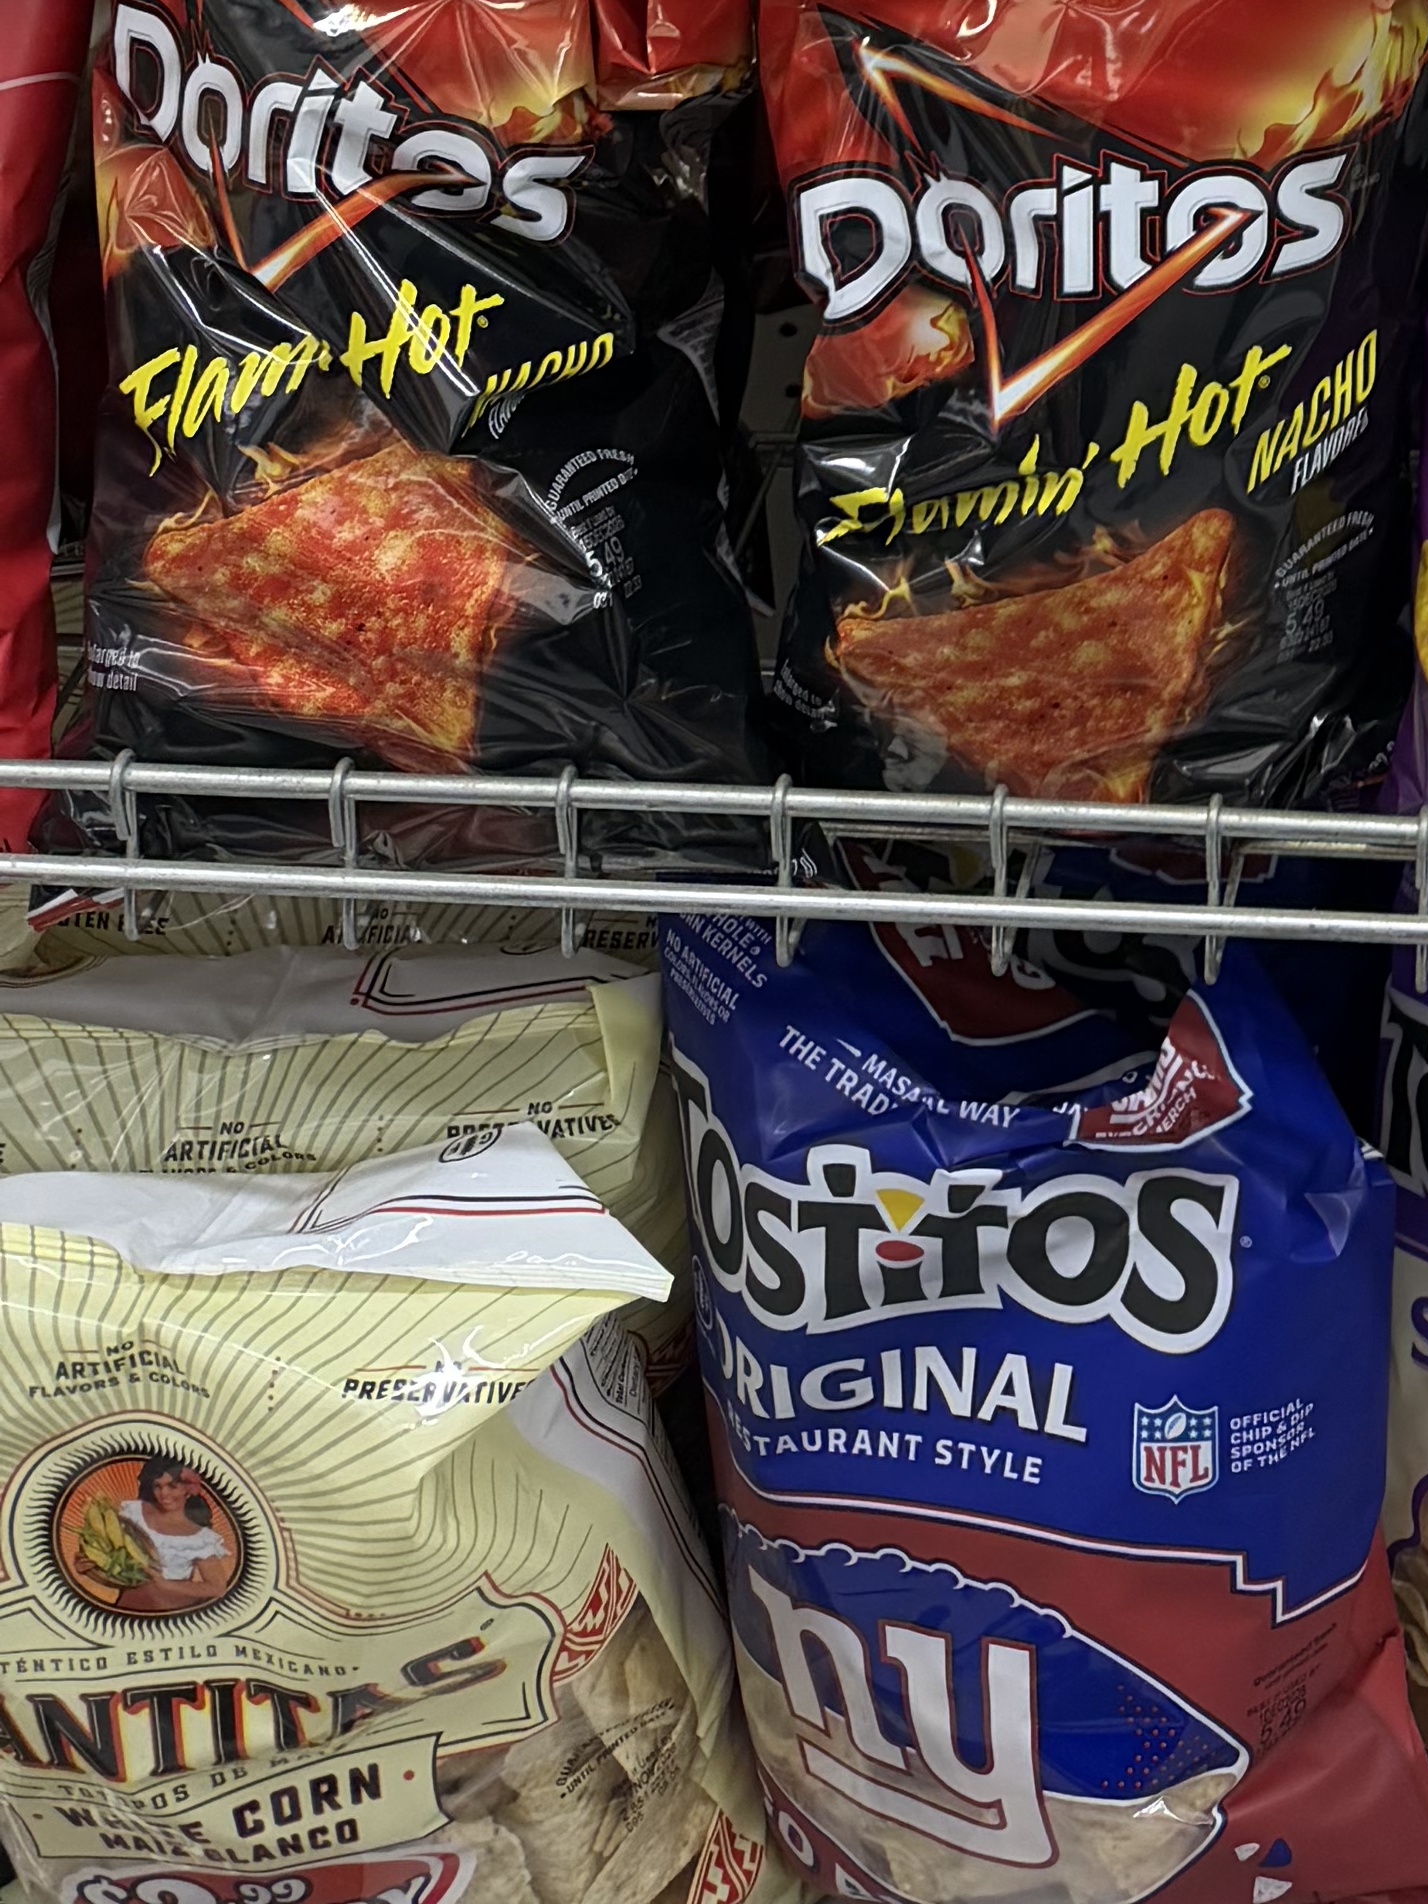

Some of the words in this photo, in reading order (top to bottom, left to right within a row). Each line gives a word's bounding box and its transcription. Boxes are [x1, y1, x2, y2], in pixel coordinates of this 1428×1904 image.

[112, 1, 595, 242] Doritos
[798, 151, 1352, 323] Doritos
[340, 278, 505, 399] Hot
[1112, 345, 1291, 486] Hot
[1247, 329, 1379, 494] NACHO
[54, 1350, 186, 1381] ARTIFICIAL
[106, 1340, 134, 1357] NO
[1230, 1398, 1304, 1428] OFFICIAL
[1231, 1427, 1272, 1443] CHIP
[1276, 1420, 1287, 1433] &
[1292, 1403, 1314, 1423] DIP
[935, 1444, 1043, 1483] STYLE
[1143, 1445, 1209, 1488] NFL
[1231, 1460, 1252, 1473] OF
[1258, 1447, 1288, 1467] THE
[1290, 1429, 1315, 1450] NFL
[232, 1764, 385, 1839] CORN
